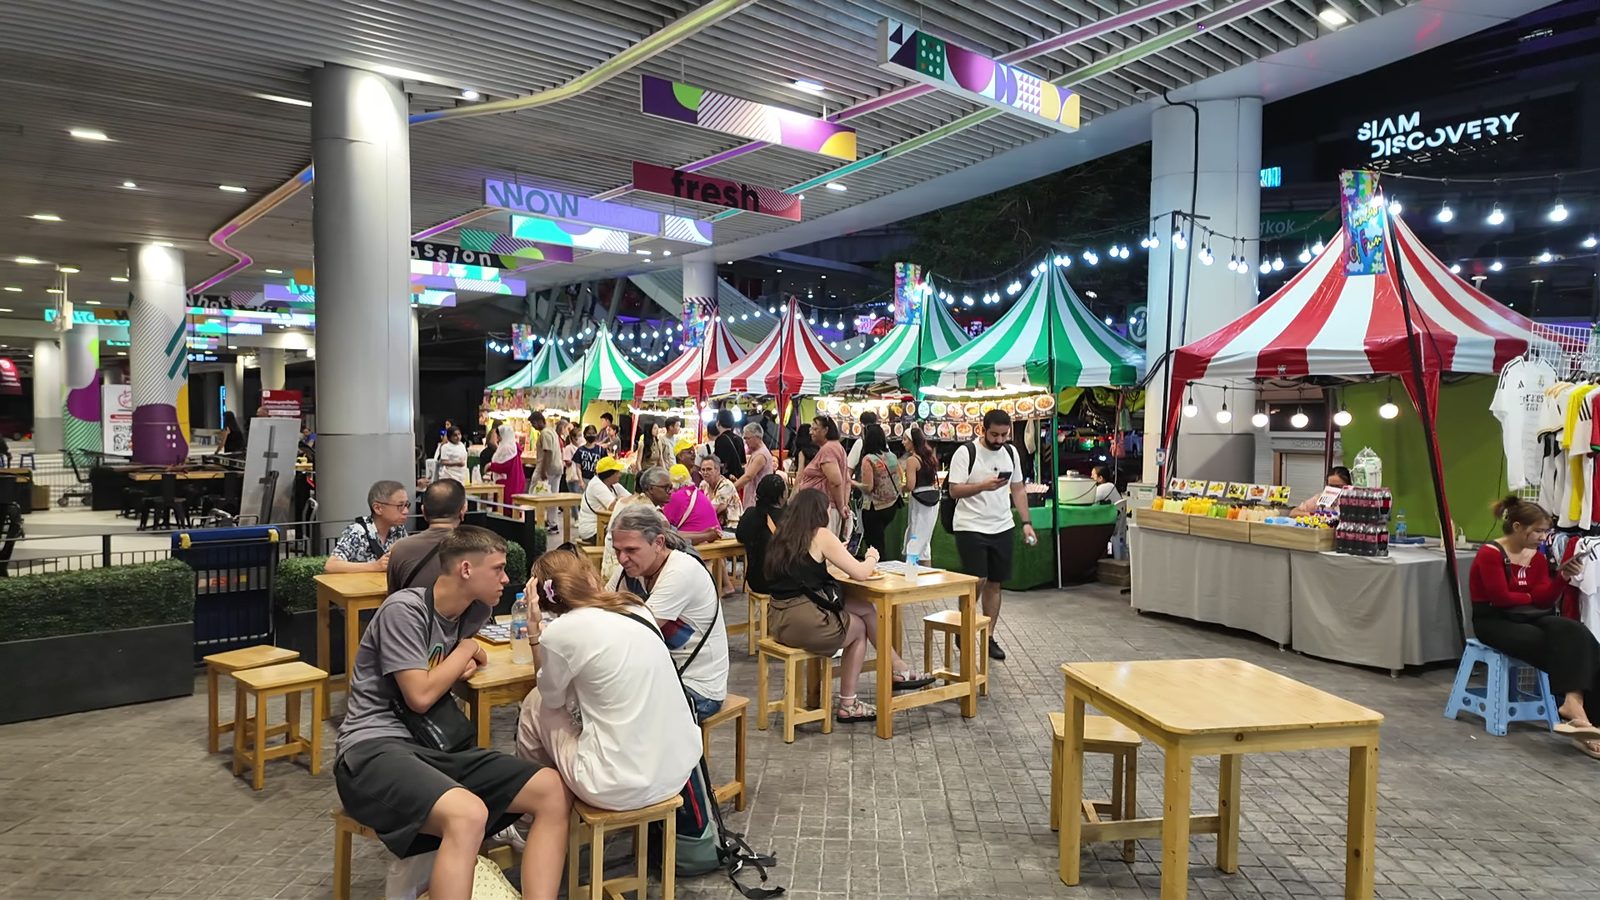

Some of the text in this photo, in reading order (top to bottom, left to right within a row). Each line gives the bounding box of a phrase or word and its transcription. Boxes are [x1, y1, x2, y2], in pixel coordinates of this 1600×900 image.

[1357, 111, 1420, 141] SIAM
[1371, 112, 1520, 158] DISCOVERY
[672, 170, 760, 212] fresh
